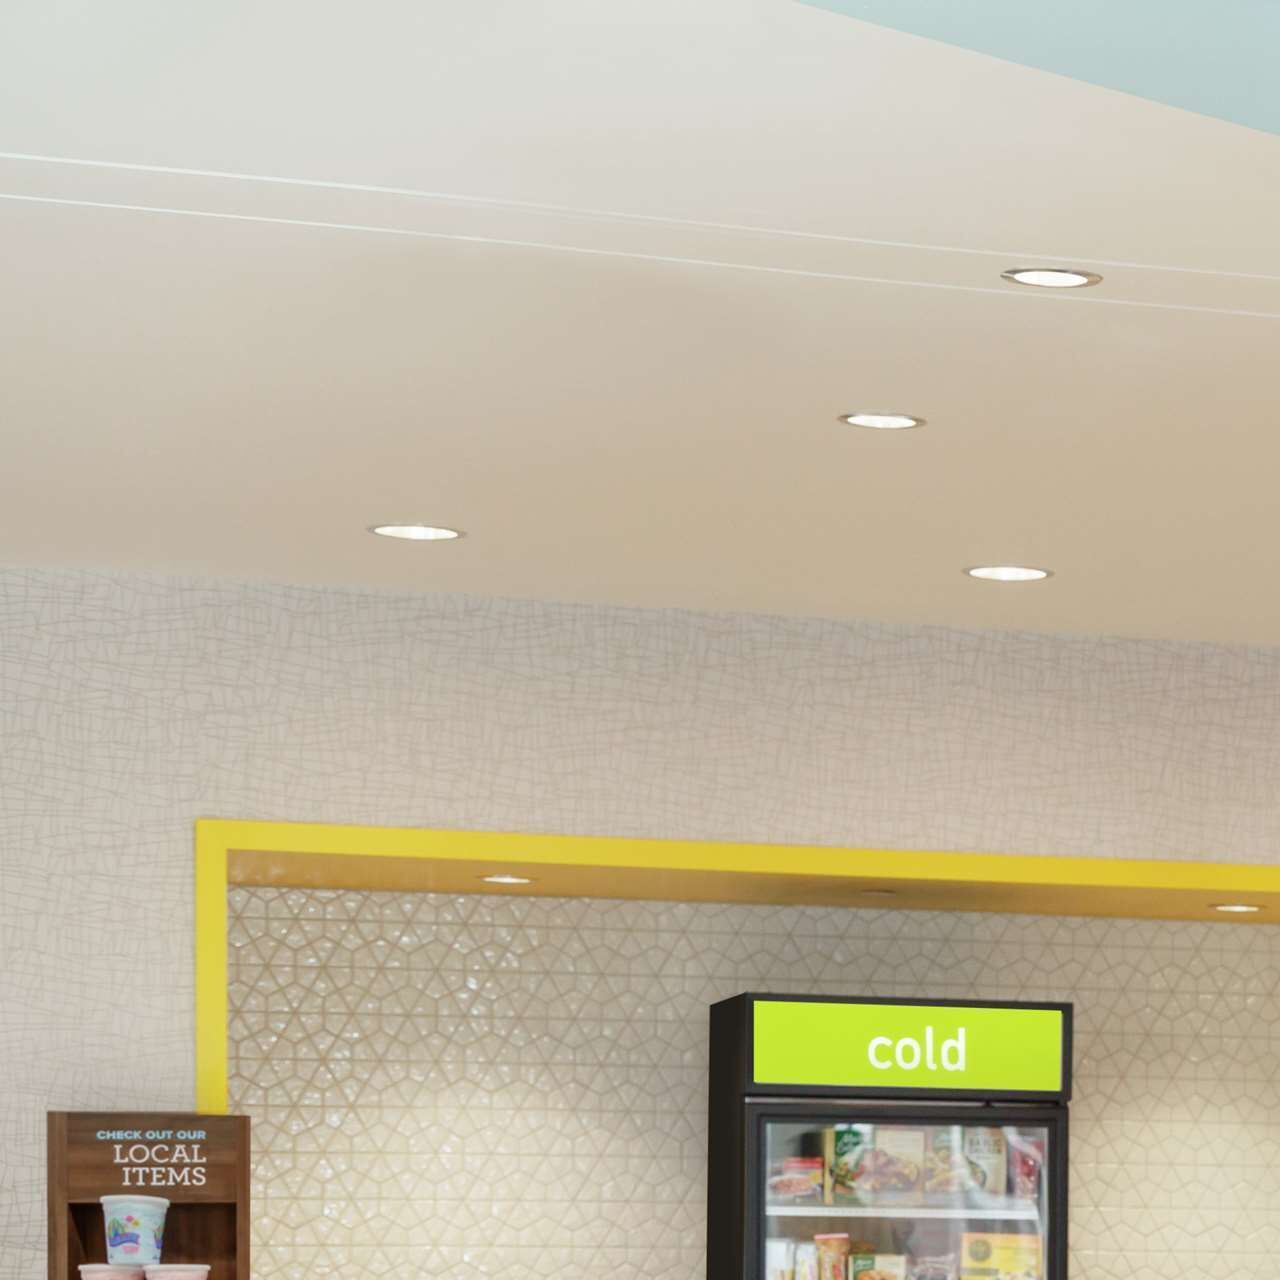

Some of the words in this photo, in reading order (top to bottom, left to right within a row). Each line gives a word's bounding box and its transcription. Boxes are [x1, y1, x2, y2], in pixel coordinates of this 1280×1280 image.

[867, 1025, 966, 1072] cold
[96, 1130, 142, 1140] CHECK
[145, 1130, 174, 1140] OUT
[176, 1130, 206, 1140] OUR
[113, 1144, 207, 1163] LOCAL
[122, 1166, 206, 1186] ITEMS
